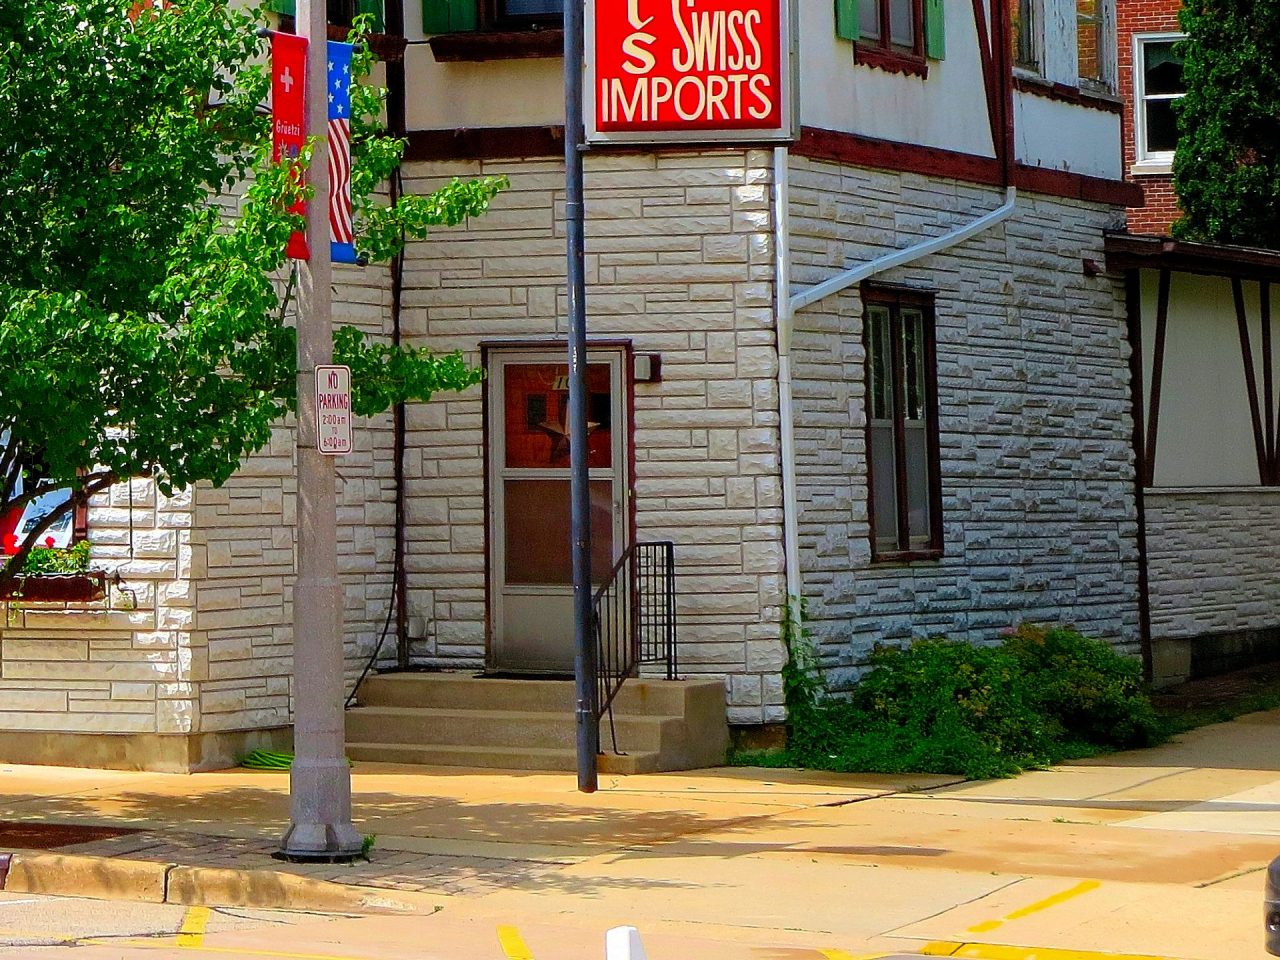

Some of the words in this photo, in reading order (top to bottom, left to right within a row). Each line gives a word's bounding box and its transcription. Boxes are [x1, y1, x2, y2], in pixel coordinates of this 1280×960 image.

[602, 74, 772, 122] IMPORTS
[276, 120, 300, 137] Grüetzi
[328, 373, 338, 389] NO
[319, 394, 347, 409] PARKING
